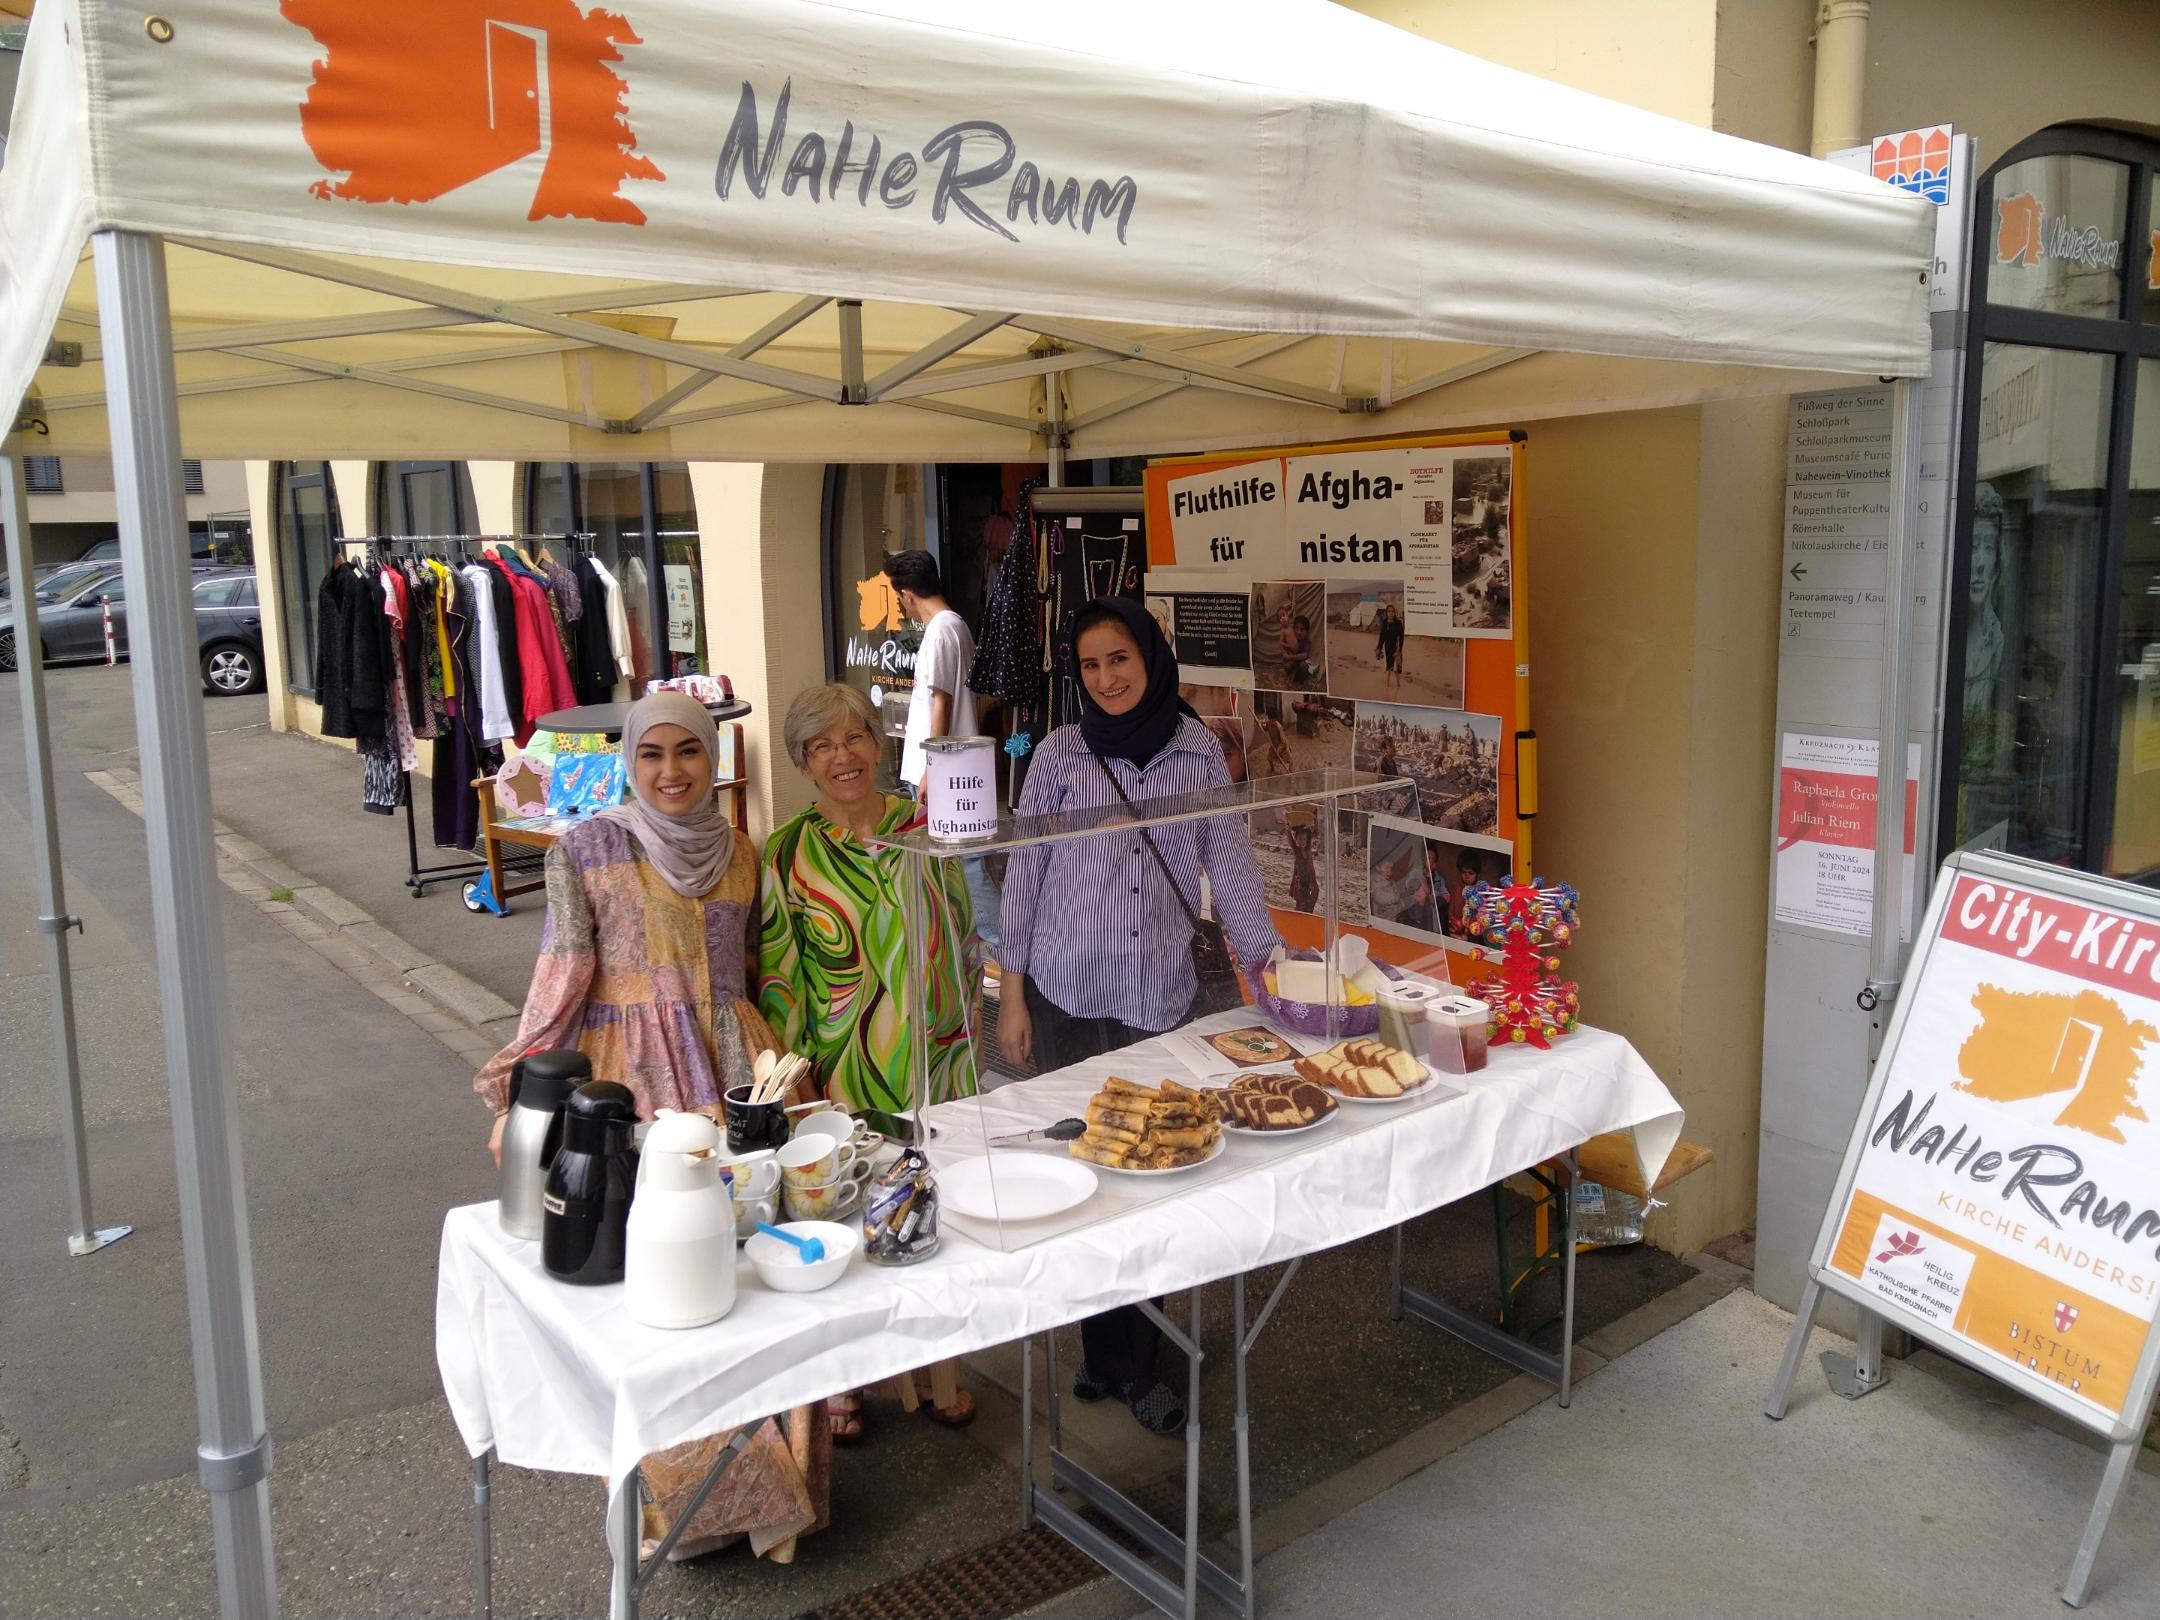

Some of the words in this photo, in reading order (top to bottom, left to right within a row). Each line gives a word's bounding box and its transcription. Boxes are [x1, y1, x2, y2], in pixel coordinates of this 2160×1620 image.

[1798, 401, 1833, 412] Fußweg
[1837, 399, 1853, 408] der
[1857, 396, 1885, 407] Sinne
[1797, 416, 1850, 429] Schloßpark
[1796, 433, 1891, 447] Schloßparkmuseum
[1795, 450, 1861, 464] Museumscafé
[1795, 468, 1891, 481] Nahewein-Vinothek
[1298, 470, 1404, 509] Afgha-
[1793, 490, 1832, 500] Museum
[1836, 488, 1851, 499] für
[1174, 477, 1276, 517] Fluthilfe
[1792, 504, 1890, 517] PuppentheaterKultu
[1792, 523, 1845, 534] Römerhalle
[1210, 536, 1245, 563] für
[1300, 532, 1404, 563] nistan
[1792, 540, 1861, 550] Nikolauskirche
[1789, 592, 1854, 605] Panoramaweg
[1788, 608, 1836, 621] Teetempel
[871, 675, 894, 685] KIRCHE
[949, 776, 984, 789] Hilfe
[1793, 781, 1845, 799] Raphaela
[956, 798, 979, 811] für
[1791, 810, 1824, 825] Julian
[1828, 815, 1861, 830] Riem
[1818, 852, 1859, 863] SONNTAG
[1818, 871, 1826, 879] 18
[1828, 873, 1847, 881] UHR
[1830, 863, 1850, 872] JUNI
[1852, 866, 1871, 875] 2024
[1937, 1190, 2028, 1243] KIRCHE
[2034, 1235, 2156, 1300] ANDERS!
[1922, 1260, 1954, 1281] HEILIG
[1869, 1266, 1919, 1297] KATHOLISCHE
[1921, 1293, 1953, 1314] PFARREI
[1926, 1275, 1960, 1297] KREUZ
[1878, 1284, 1894, 1297] BAD
[1894, 1291, 1938, 1320] KREUZNACH
[2009, 1321, 2102, 1379] BISTUM
[2013, 1348, 2082, 1394] TRIER
